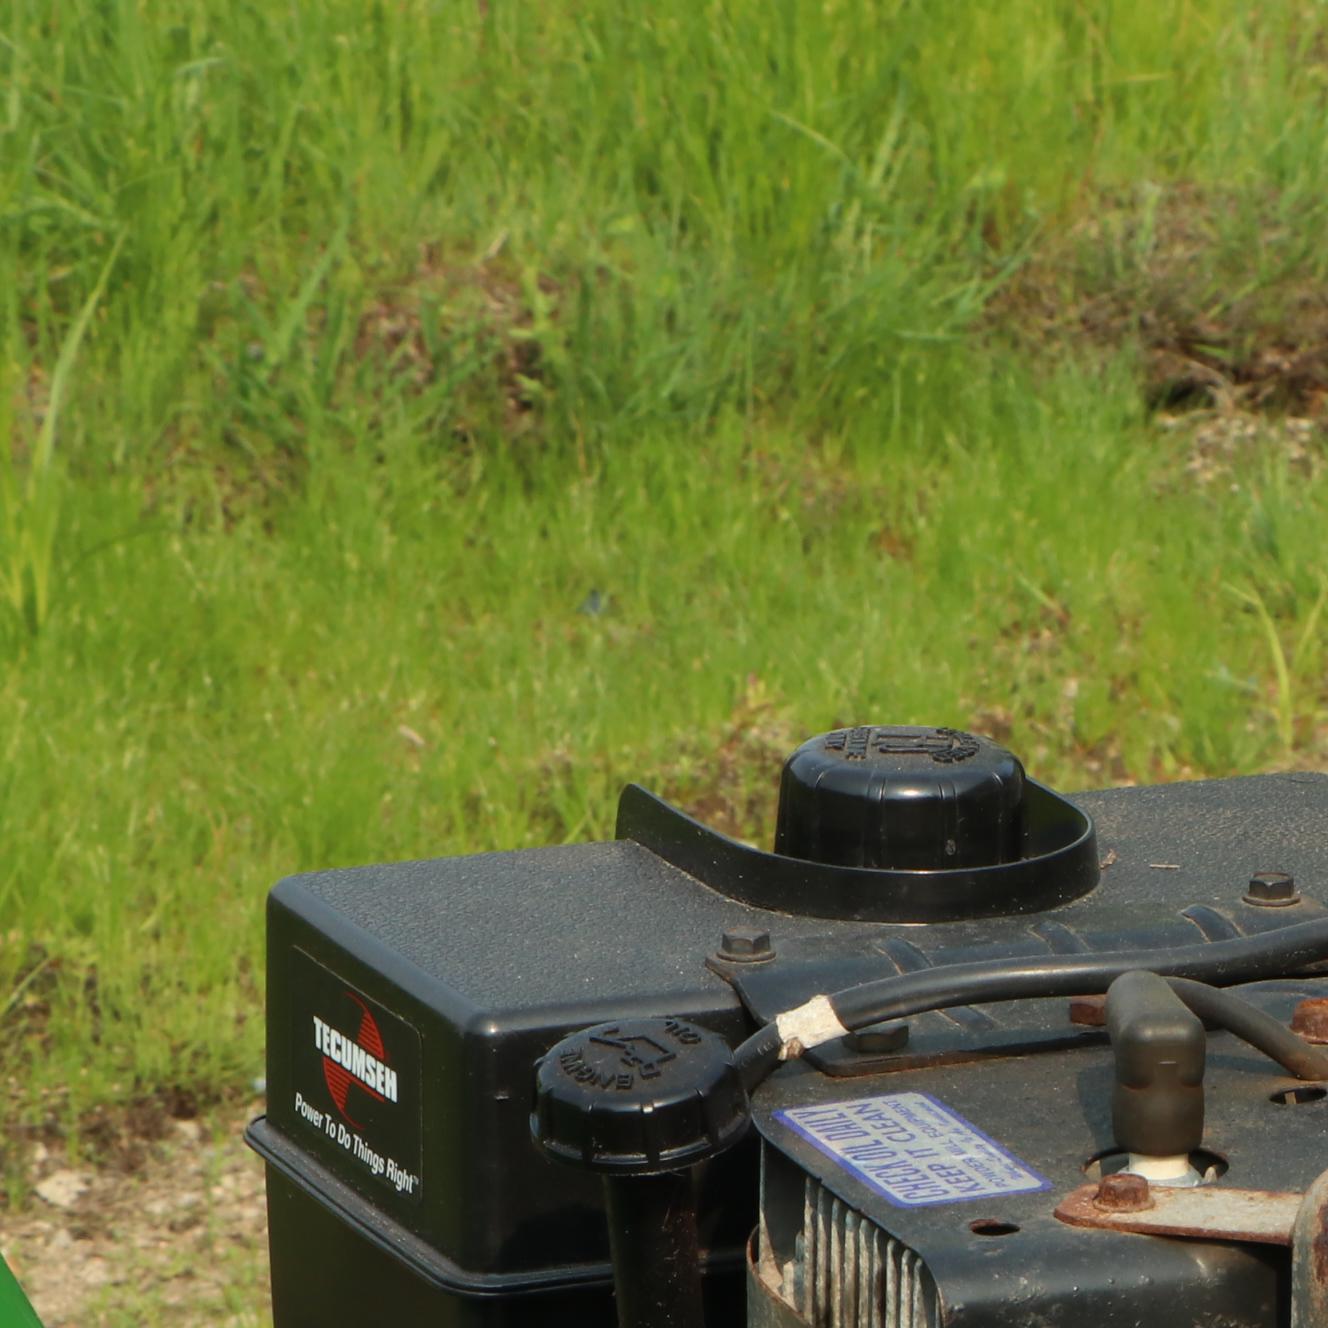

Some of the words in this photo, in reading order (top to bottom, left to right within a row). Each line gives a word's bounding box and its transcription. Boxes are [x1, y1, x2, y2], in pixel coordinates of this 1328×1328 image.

[313, 1015, 398, 1103] TECUMSEH
[295, 1092, 324, 1128] Power
[325, 1113, 336, 1139] To
[338, 1125, 351, 1150] Do
[353, 1134, 385, 1176] Things
[793, 1108, 868, 1141] DAILY
[847, 1102, 917, 1143] CLEAN
[839, 1139, 898, 1162] OIL
[903, 1147, 935, 1159] IT
[861, 1160, 951, 1200] CHECK
[927, 1162, 986, 1193] KEEP
